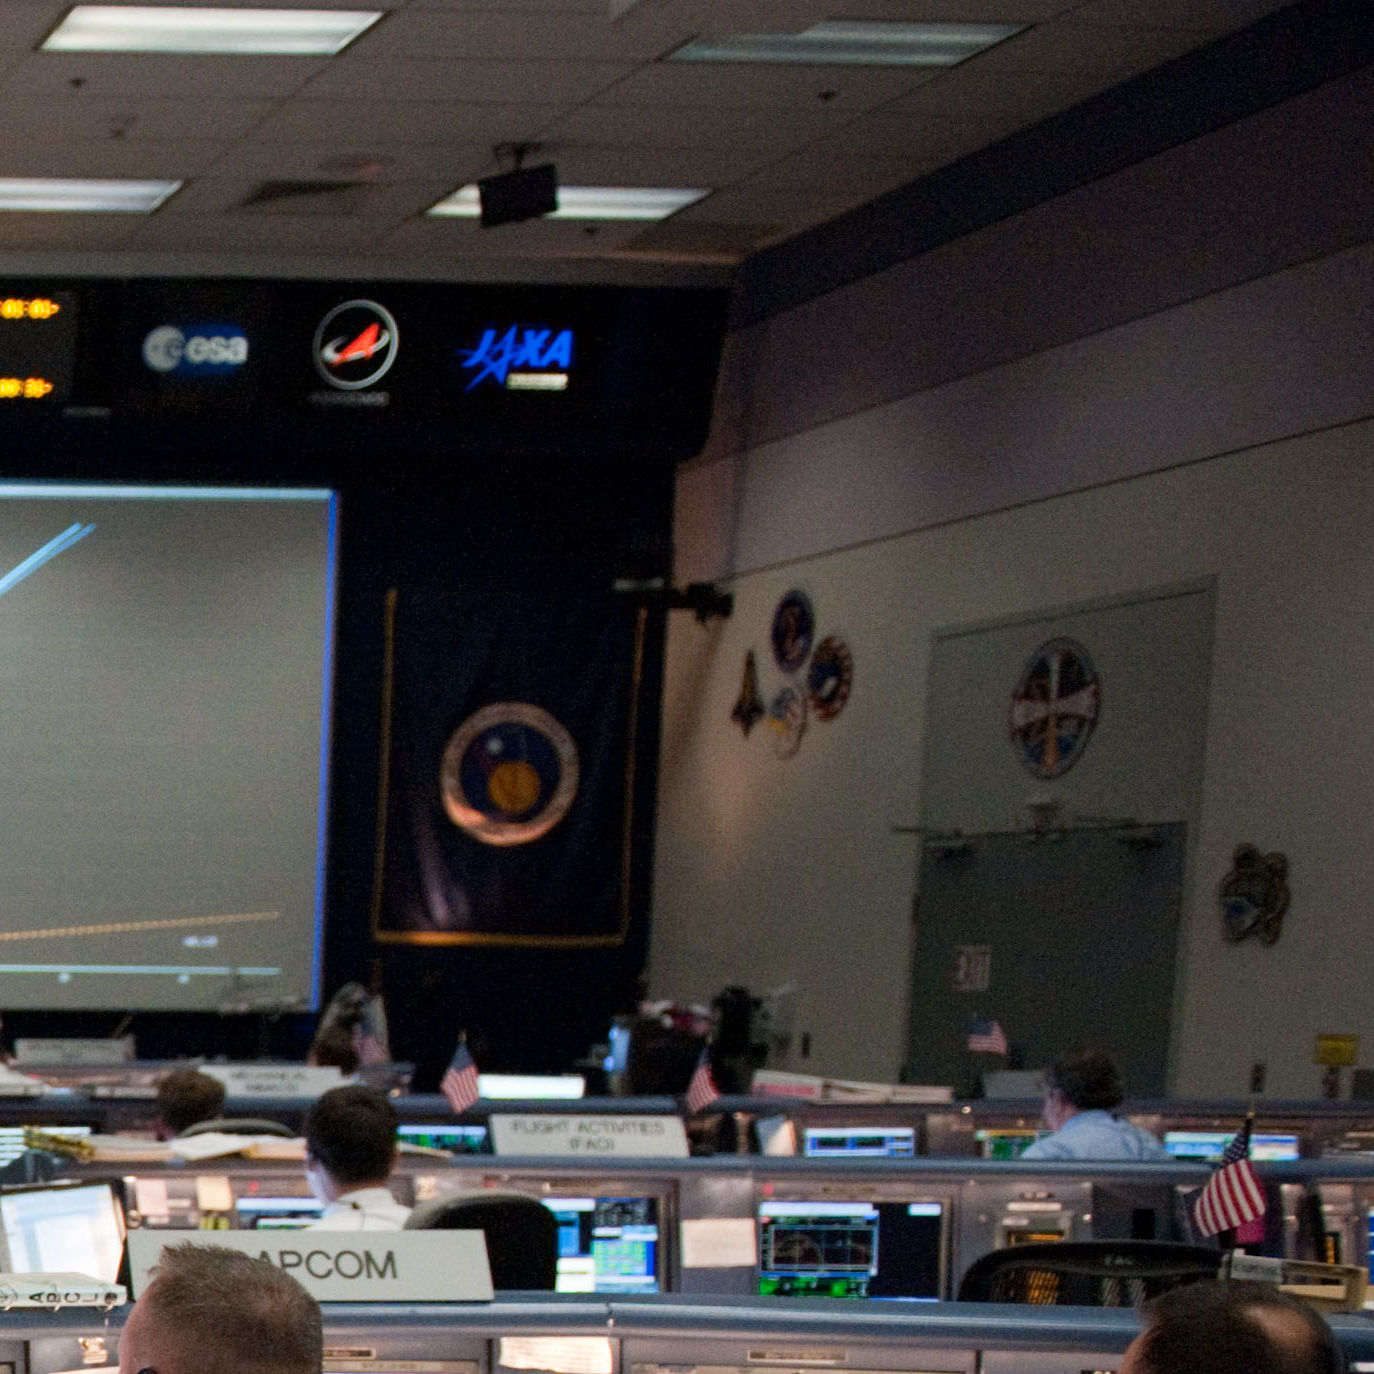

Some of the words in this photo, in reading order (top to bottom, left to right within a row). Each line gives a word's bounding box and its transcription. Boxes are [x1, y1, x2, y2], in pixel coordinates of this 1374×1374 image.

[184, 336, 249, 366] esa
[460, 327, 573, 386] JAXA
[577, 1118, 666, 1136] ACTIVITIES
[254, 1250, 399, 1280] APCOM
